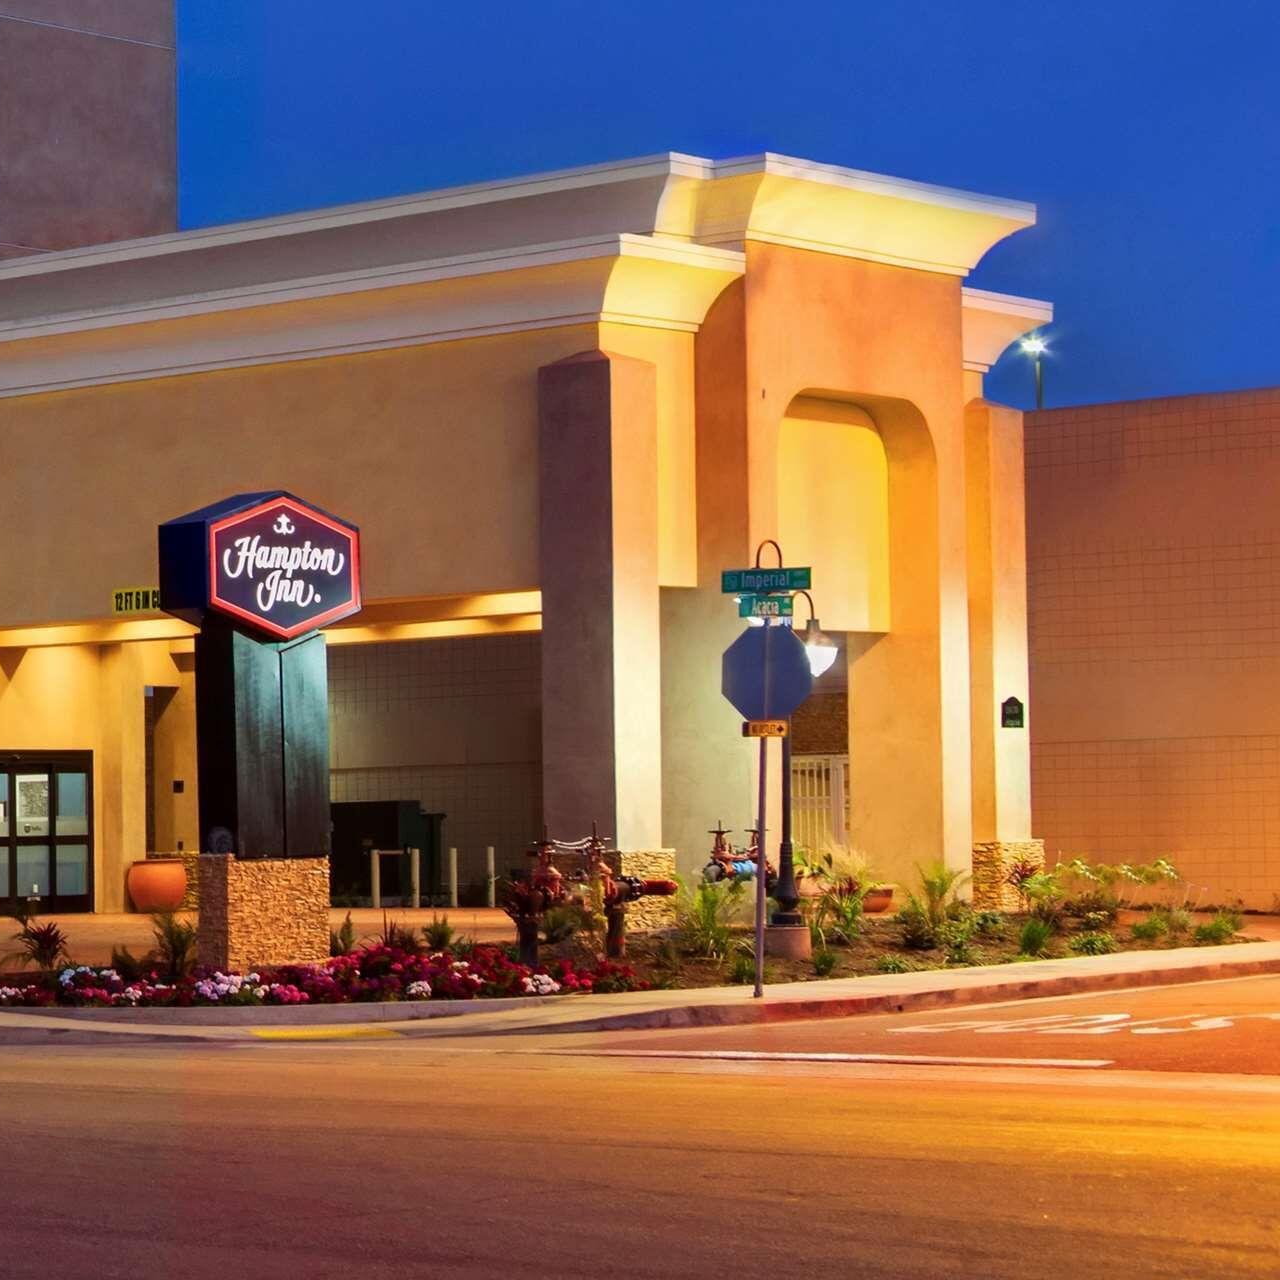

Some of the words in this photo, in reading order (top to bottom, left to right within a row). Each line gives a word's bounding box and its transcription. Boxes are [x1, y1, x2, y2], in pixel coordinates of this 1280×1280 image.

[223, 535, 345, 579] Hampton
[741, 571, 790, 589] Imperial
[114, 592, 123, 611] 12
[124, 591, 133, 610] FT
[751, 597, 780, 616] Acacia
